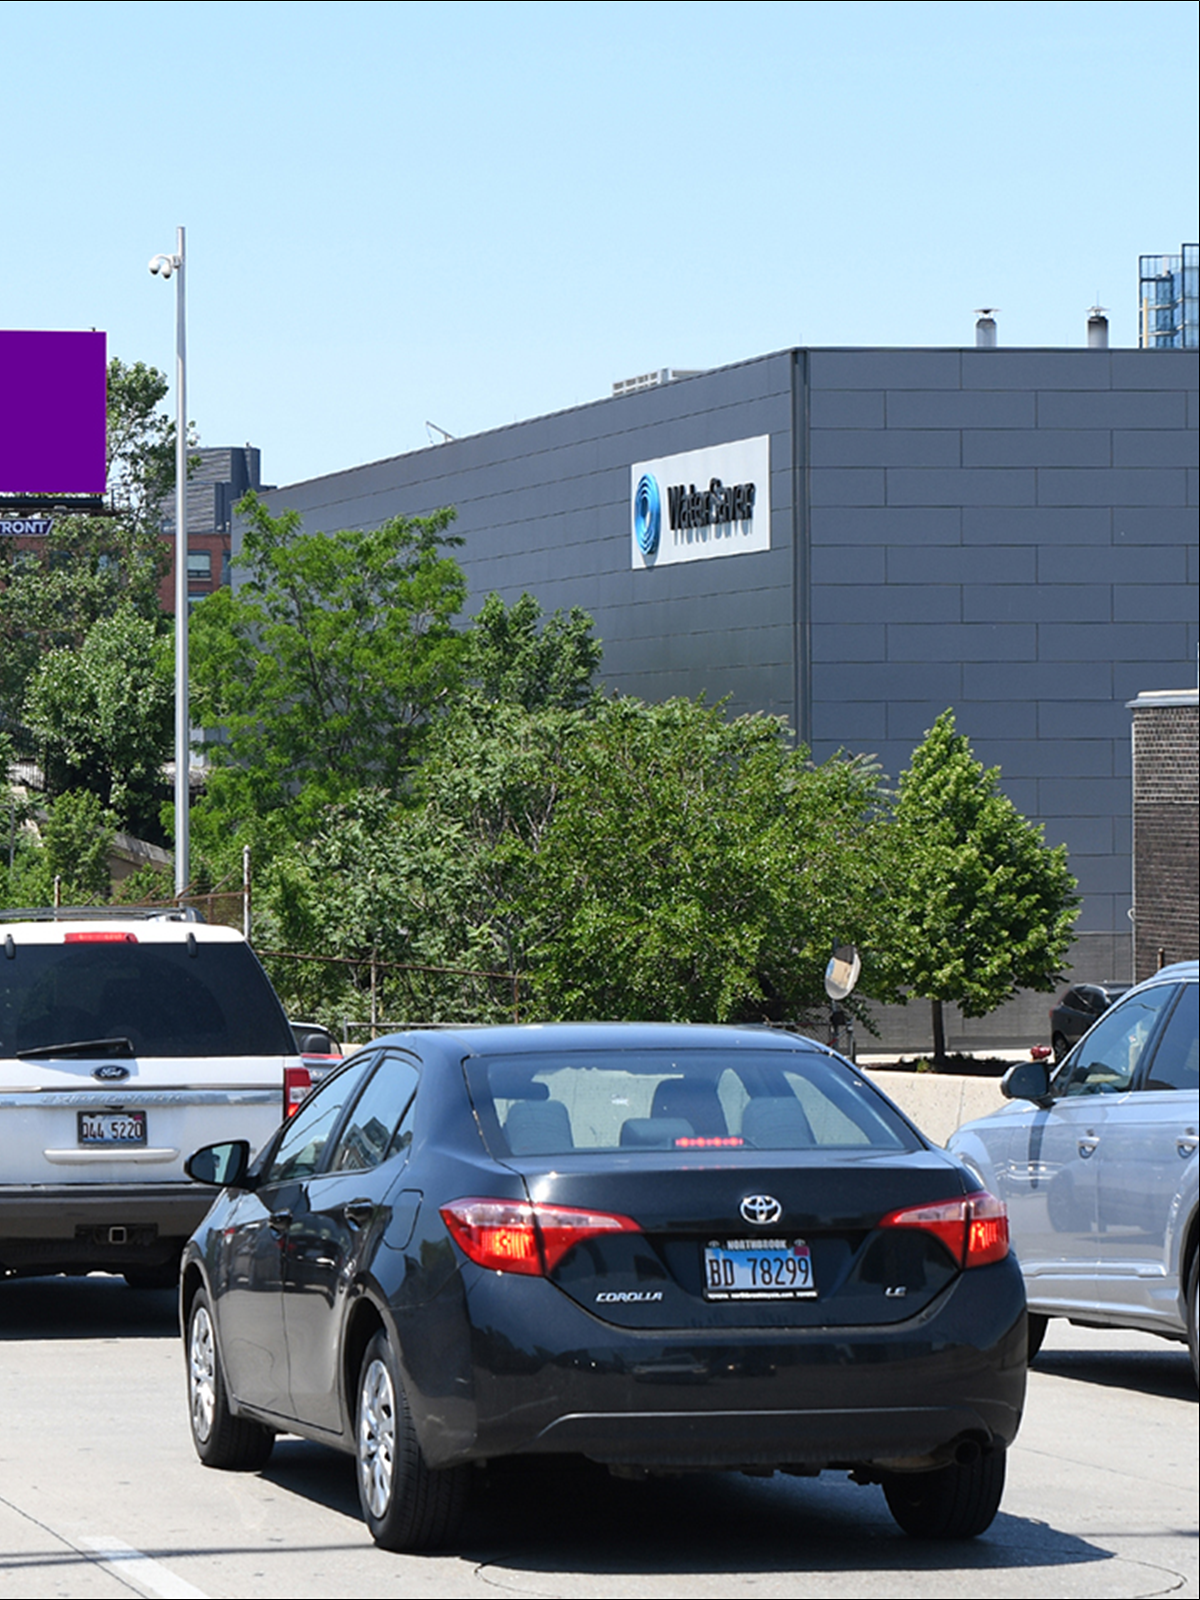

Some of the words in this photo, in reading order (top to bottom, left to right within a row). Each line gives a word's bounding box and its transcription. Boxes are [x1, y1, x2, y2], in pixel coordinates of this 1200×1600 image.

[111, 1121, 143, 1139] 5220
[709, 1259, 735, 1287] BD
[746, 1257, 809, 1286] 78299
[596, 1292, 663, 1303] COROLLA
[885, 1286, 906, 1297] LE
